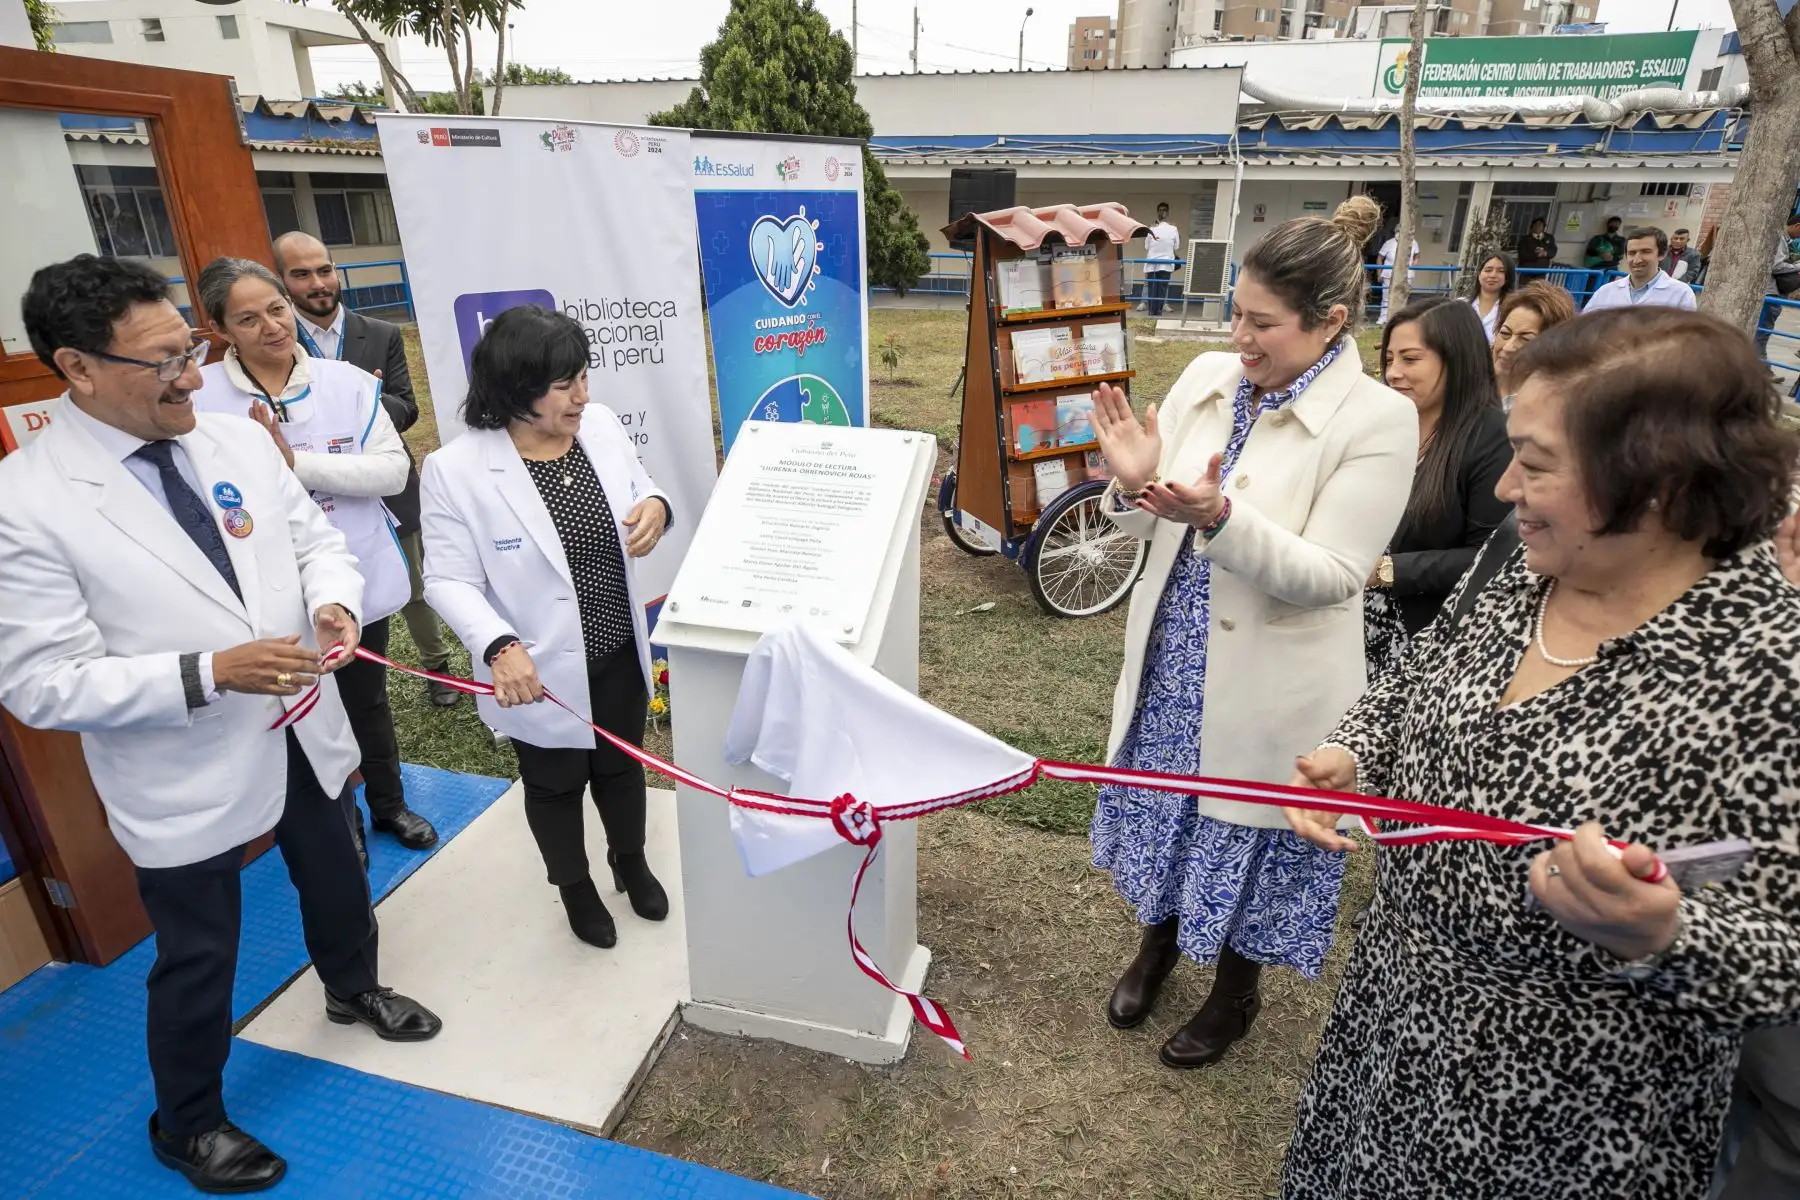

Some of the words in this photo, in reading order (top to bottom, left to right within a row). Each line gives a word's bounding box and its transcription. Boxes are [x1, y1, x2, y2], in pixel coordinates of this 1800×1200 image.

[1423, 58, 1480, 81] FEDERACIÓN
[1481, 63, 1517, 81] CENTRO
[1517, 58, 1548, 81] UNIÓN
[1548, 62, 1564, 80] DE
[1562, 60, 1636, 80] TRABAJADORES
[1640, 57, 1687, 78] ESSALUD
[716, 163, 754, 177] EsSalud
[563, 297, 678, 321] biblioteca
[587, 319, 664, 345] acional
[755, 313, 806, 330] CUIDANDO
[754, 320, 827, 357] corazón
[588, 346, 606, 369] el
[613, 342, 664, 372] perú
[825, 463, 857, 471] LECTURA
